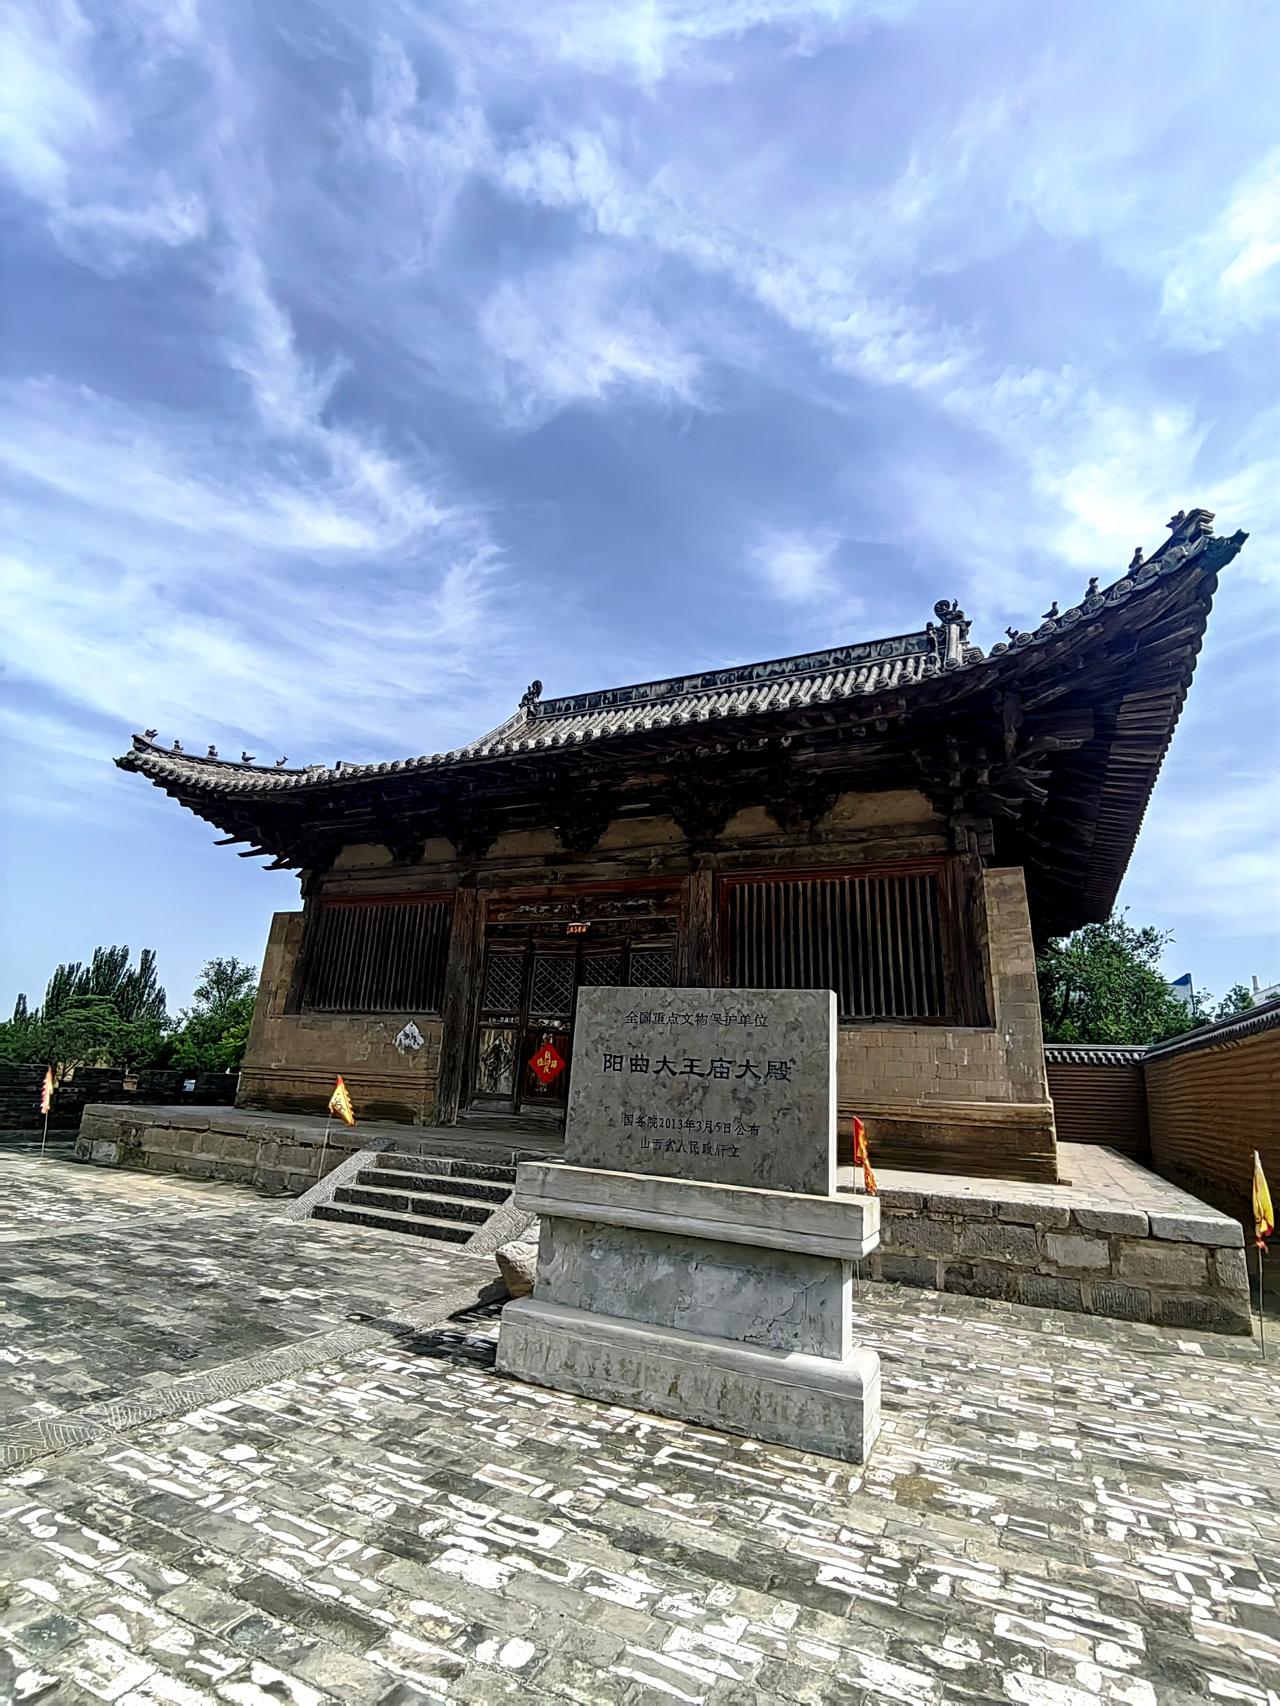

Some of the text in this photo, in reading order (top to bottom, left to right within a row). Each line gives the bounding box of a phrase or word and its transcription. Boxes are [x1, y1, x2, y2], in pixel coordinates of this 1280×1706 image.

[603, 1053, 795, 1083] 阳曲大王庙大殿
